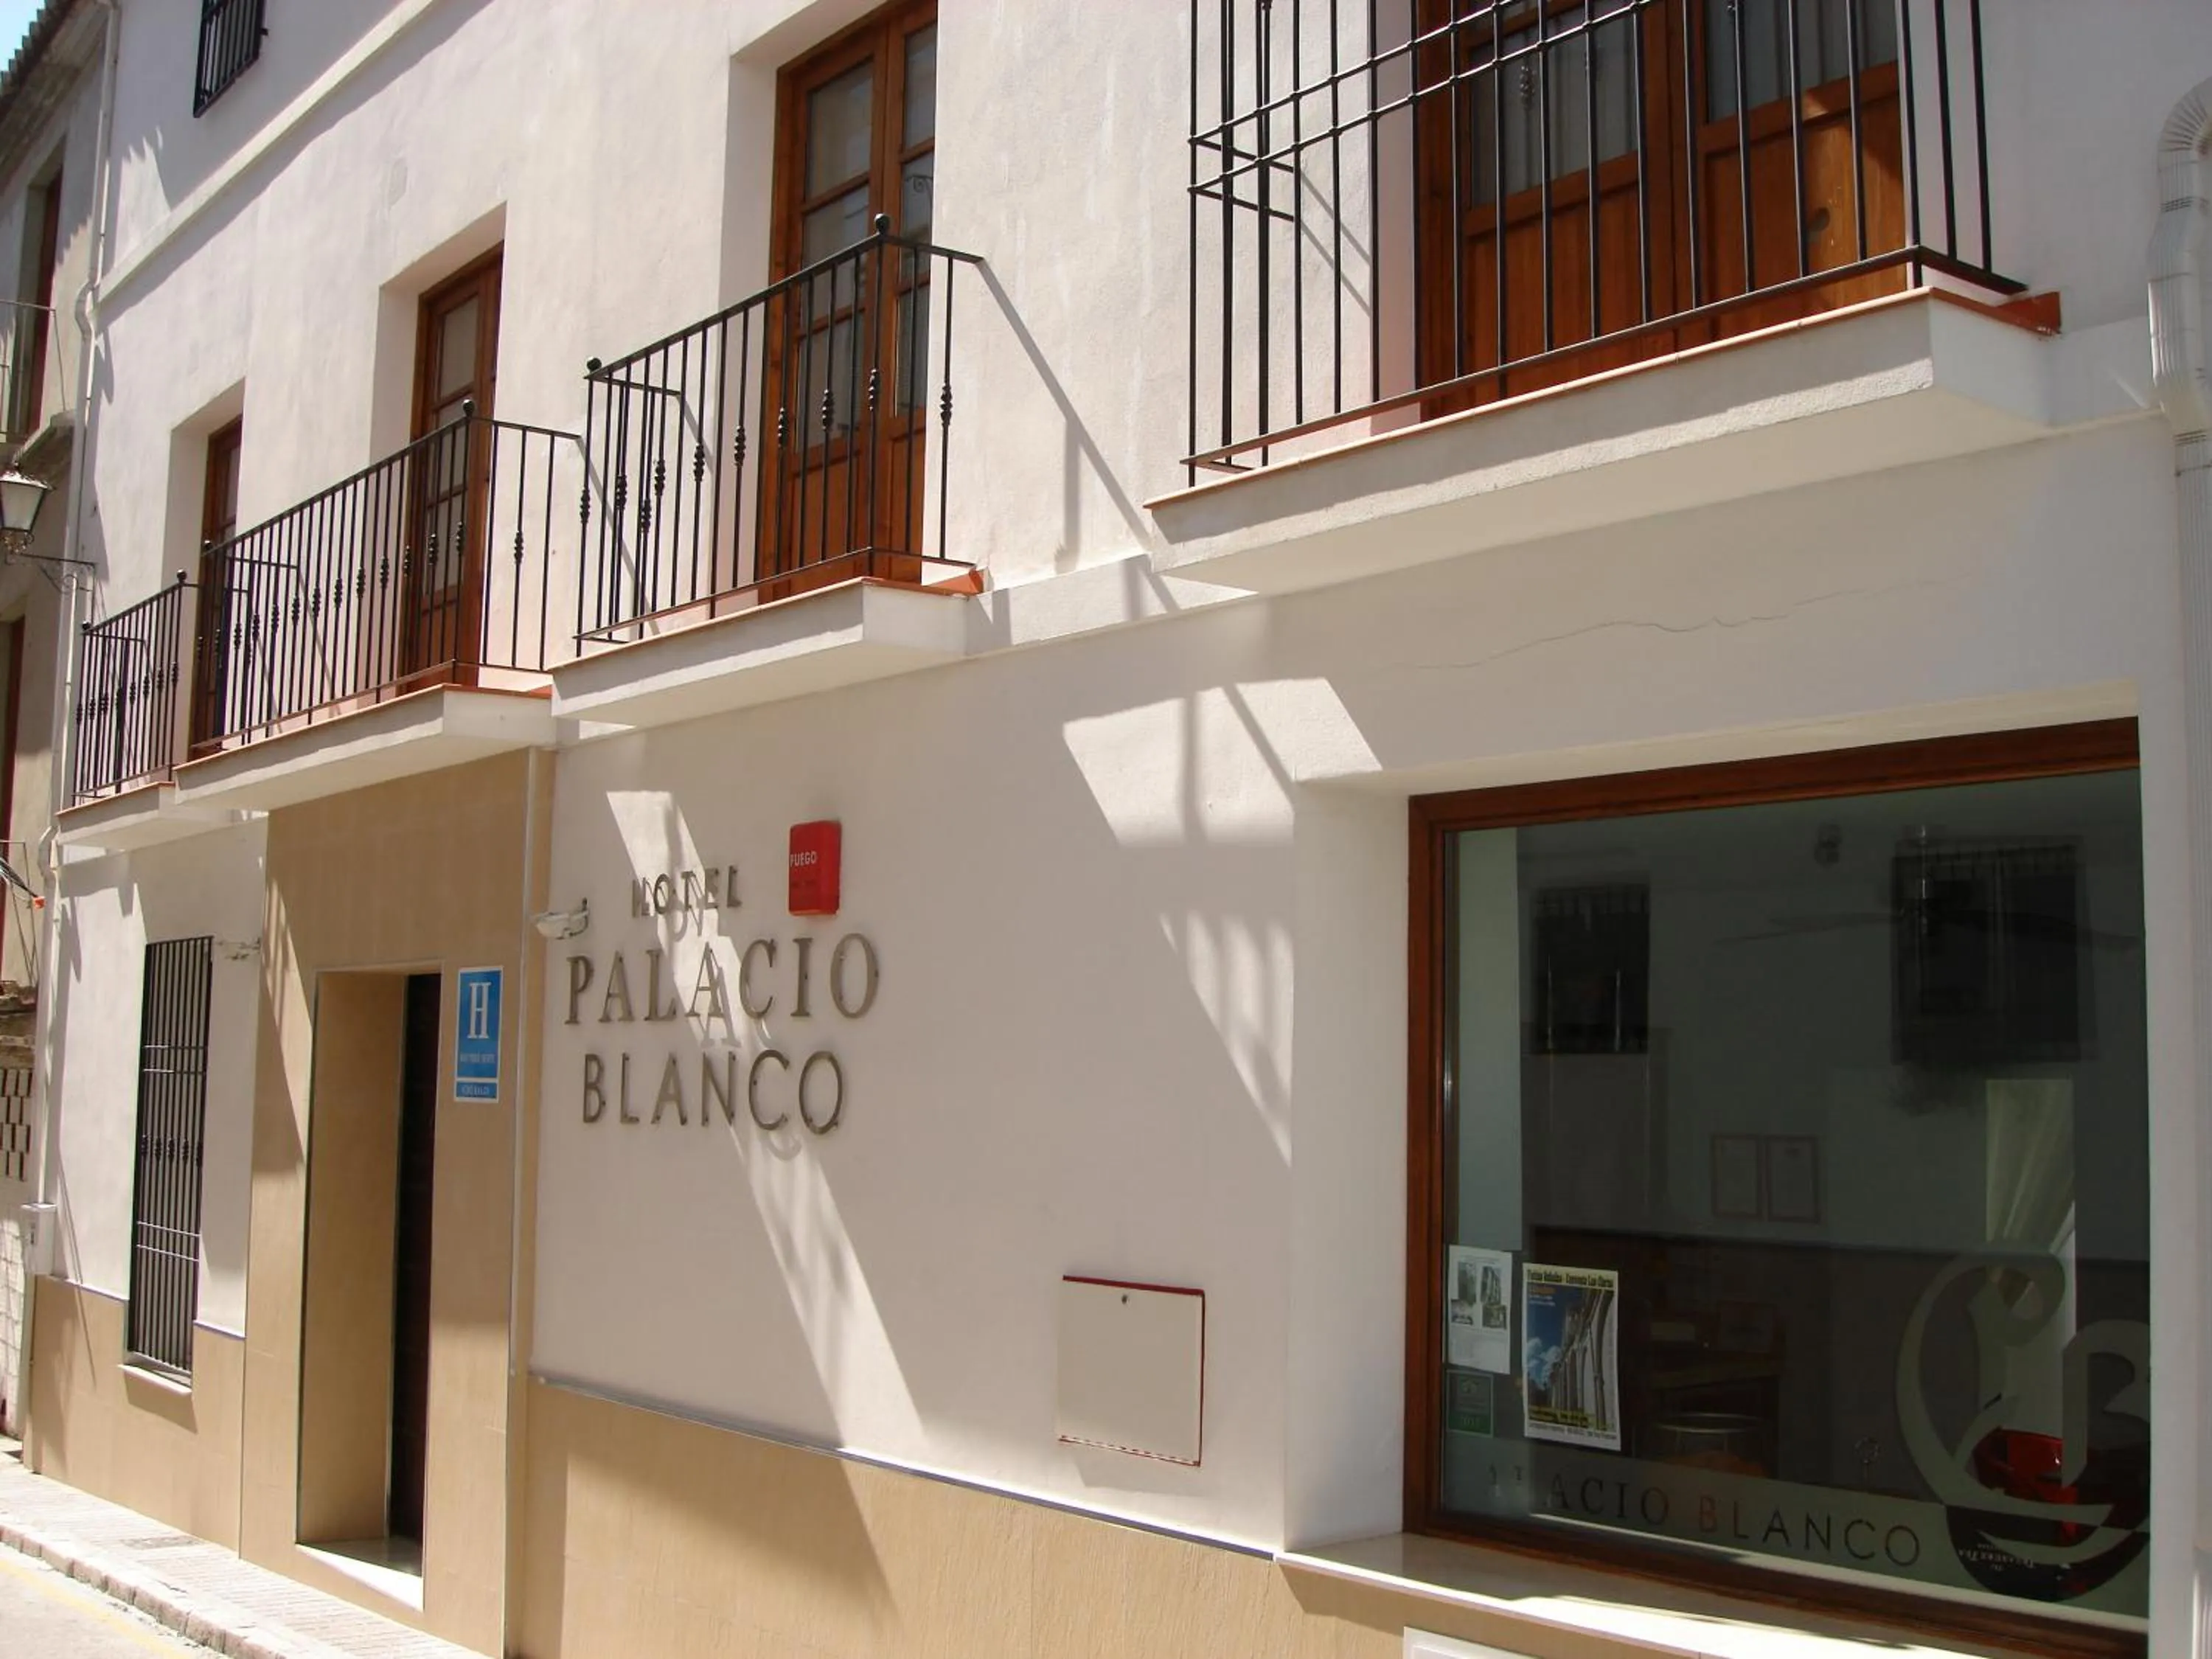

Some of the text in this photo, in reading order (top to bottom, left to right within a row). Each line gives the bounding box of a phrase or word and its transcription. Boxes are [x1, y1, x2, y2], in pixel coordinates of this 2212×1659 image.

[632, 865, 742, 918] HOTEL
[790, 851, 818, 867] FUEGO
[467, 981, 492, 1039] H
[565, 933, 879, 1025] PALACIO
[582, 1048, 844, 1135] BLANCO
[1697, 1495, 1920, 1567] BLANCO
